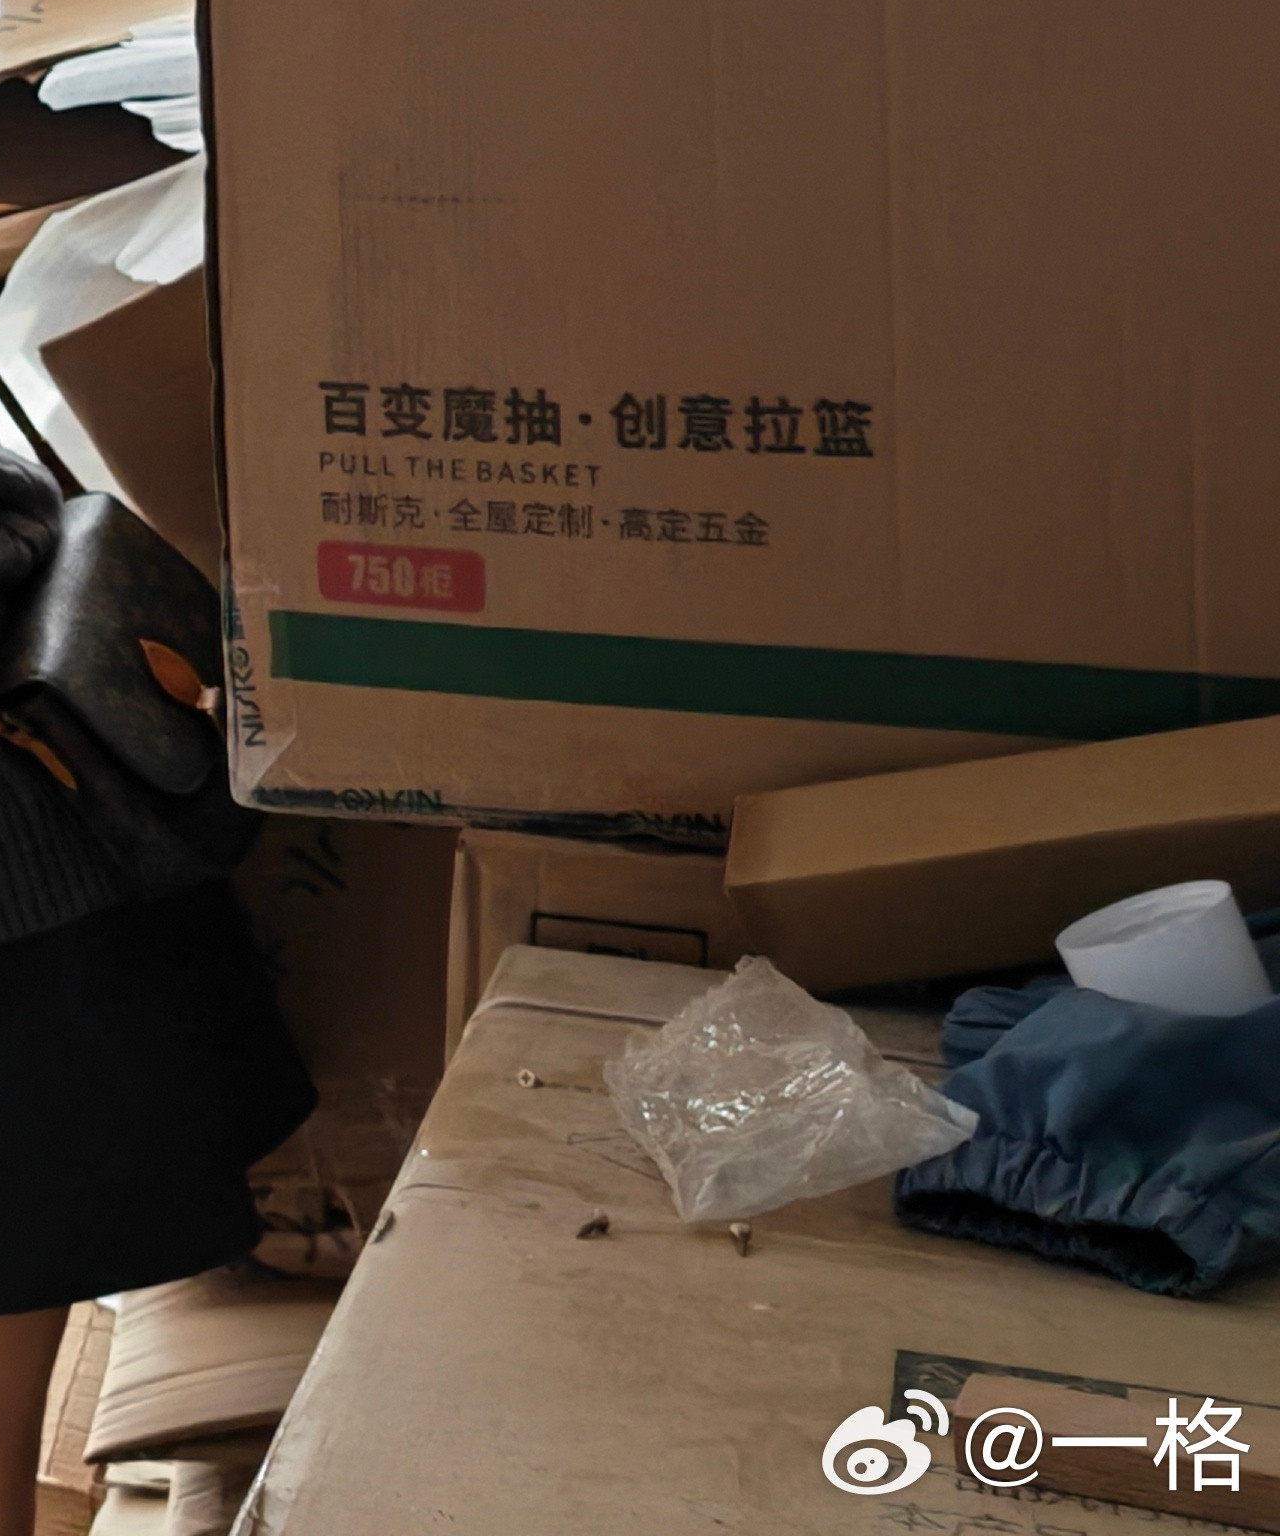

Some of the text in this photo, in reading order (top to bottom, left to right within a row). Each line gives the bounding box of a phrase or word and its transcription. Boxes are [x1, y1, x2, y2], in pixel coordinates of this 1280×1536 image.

[318, 380, 876, 459] 百变魔抽·创意拉篮
[319, 452, 602, 489] PULL THE BASKET
